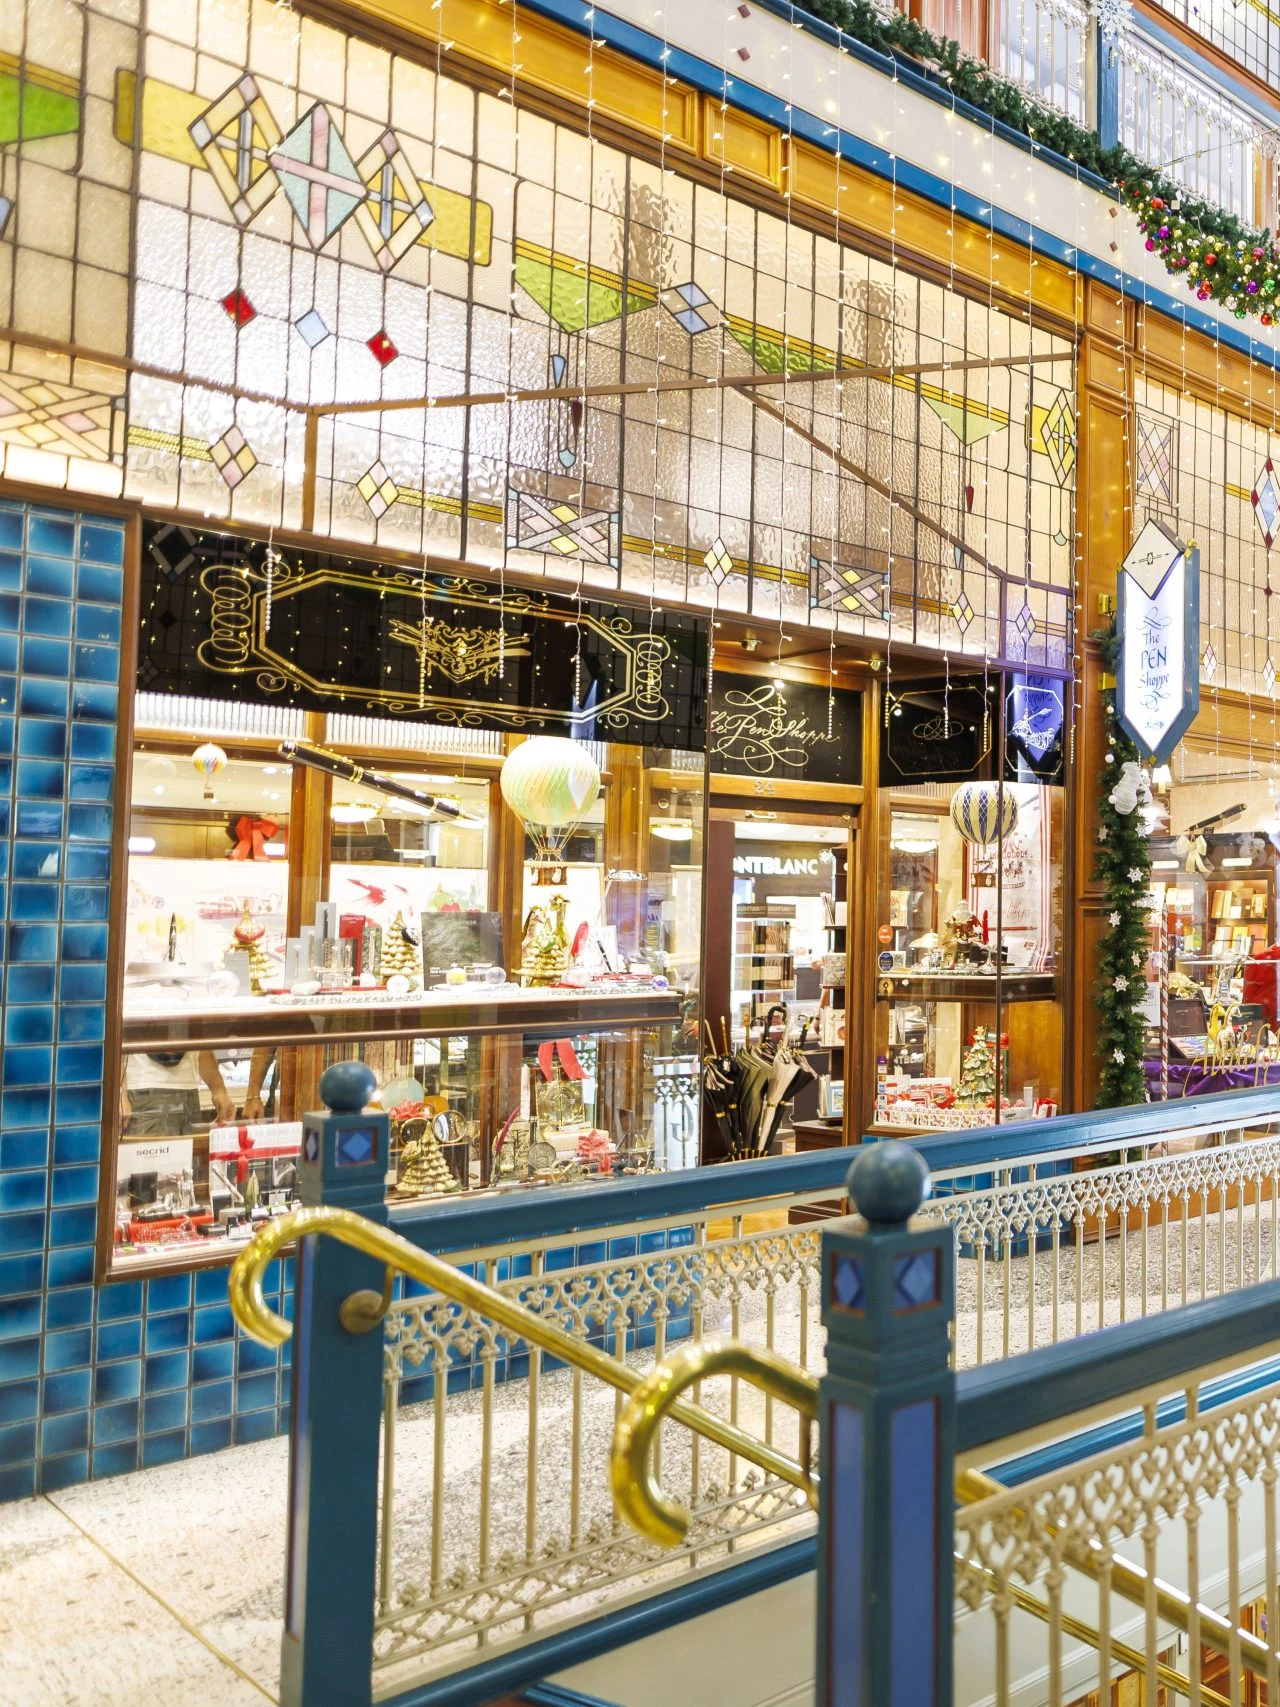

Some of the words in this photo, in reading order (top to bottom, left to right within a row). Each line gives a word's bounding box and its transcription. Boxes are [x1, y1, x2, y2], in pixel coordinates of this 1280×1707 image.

[1142, 629, 1161, 646] The
[1140, 646, 1167, 670] PEN
[1138, 672, 1170, 689] Shoppe
[136, 1146, 169, 1156] secrid
